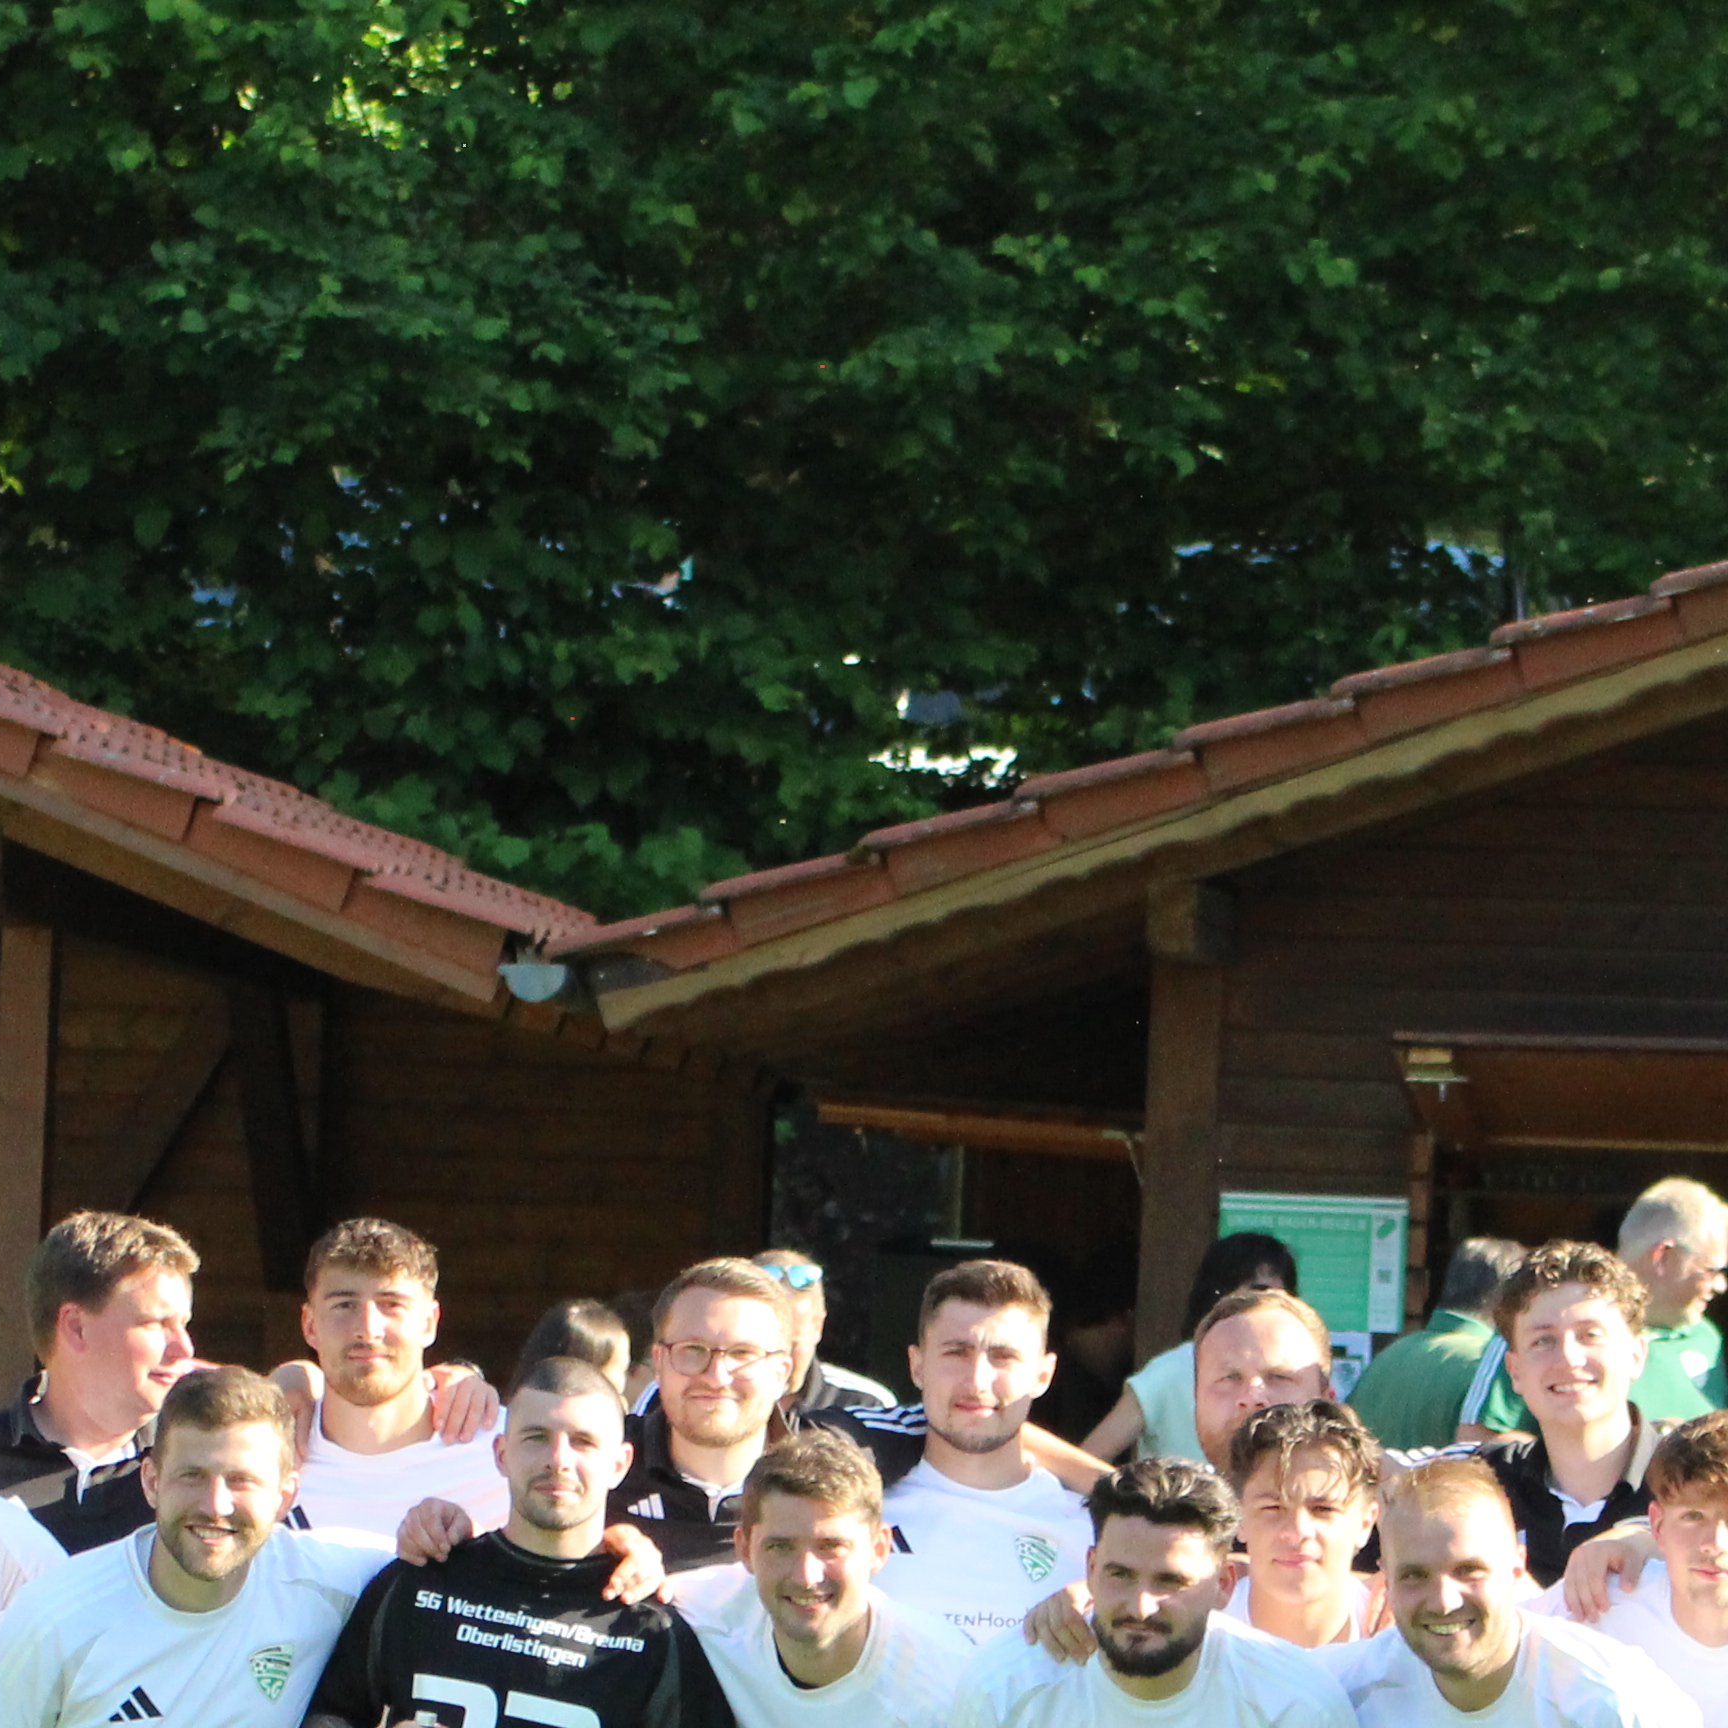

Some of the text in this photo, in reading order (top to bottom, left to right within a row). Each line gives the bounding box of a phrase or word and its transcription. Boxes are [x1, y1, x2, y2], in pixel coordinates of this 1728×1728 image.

[414, 1589, 645, 1653] SG Wettesingen/Breuna
[455, 1623, 588, 1668] Oberlistingen
